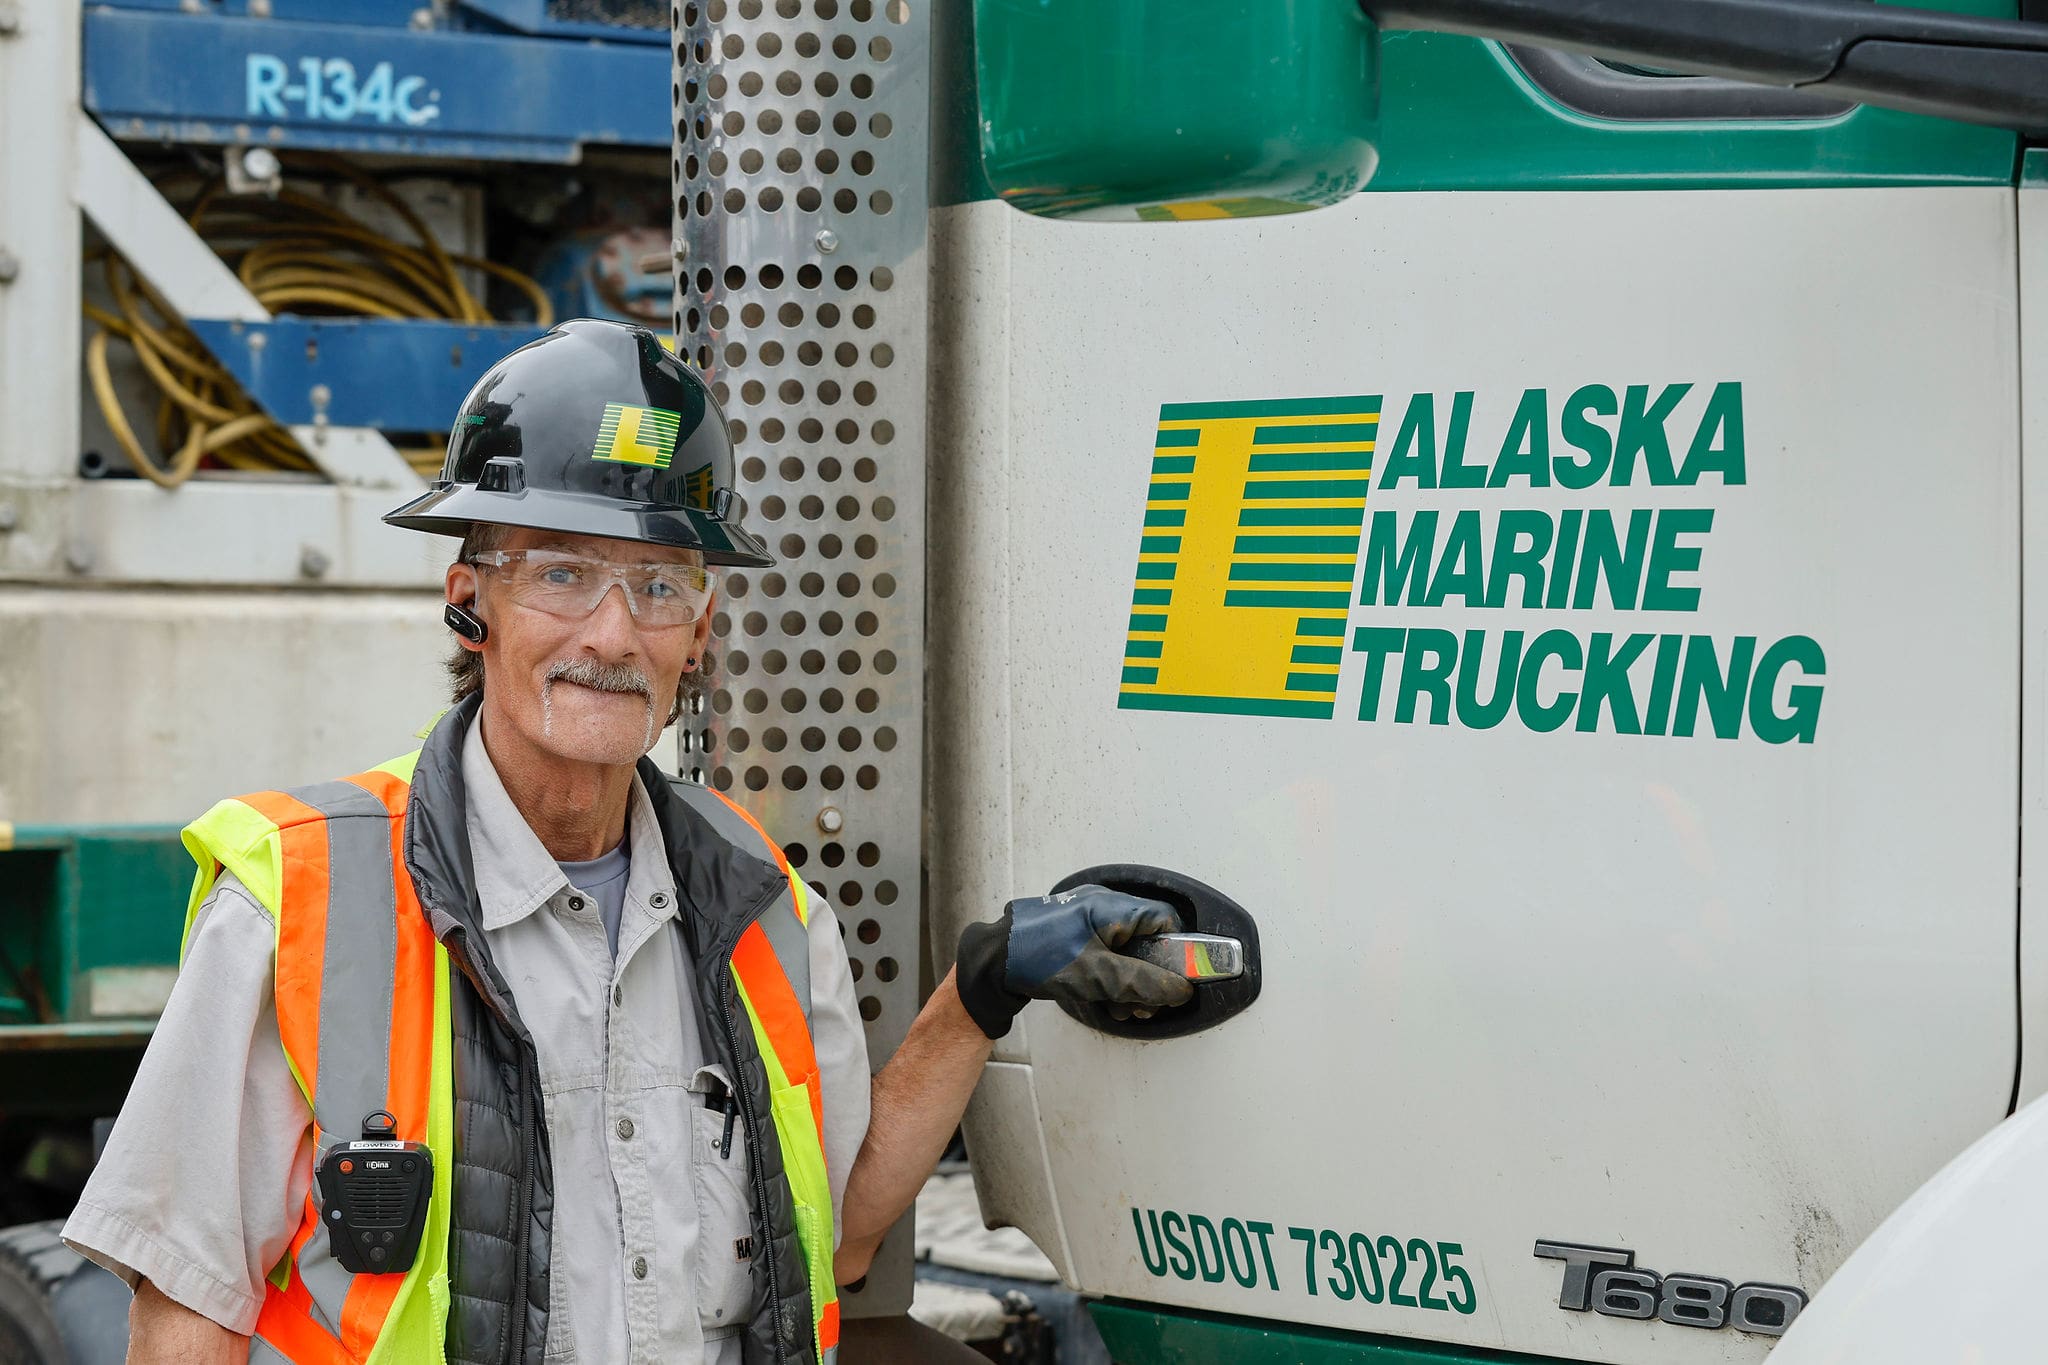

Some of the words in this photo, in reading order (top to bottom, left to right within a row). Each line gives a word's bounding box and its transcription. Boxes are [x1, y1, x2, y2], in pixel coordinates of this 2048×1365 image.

[1378, 382, 1747, 489] ALASKA
[1359, 509, 1715, 612] MARINE
[1352, 627, 1827, 745] TRUCKING
[1132, 1207, 1280, 1291] USDOT
[1287, 1226, 1478, 1315] 730225
[1534, 1239, 1809, 1337] T680
